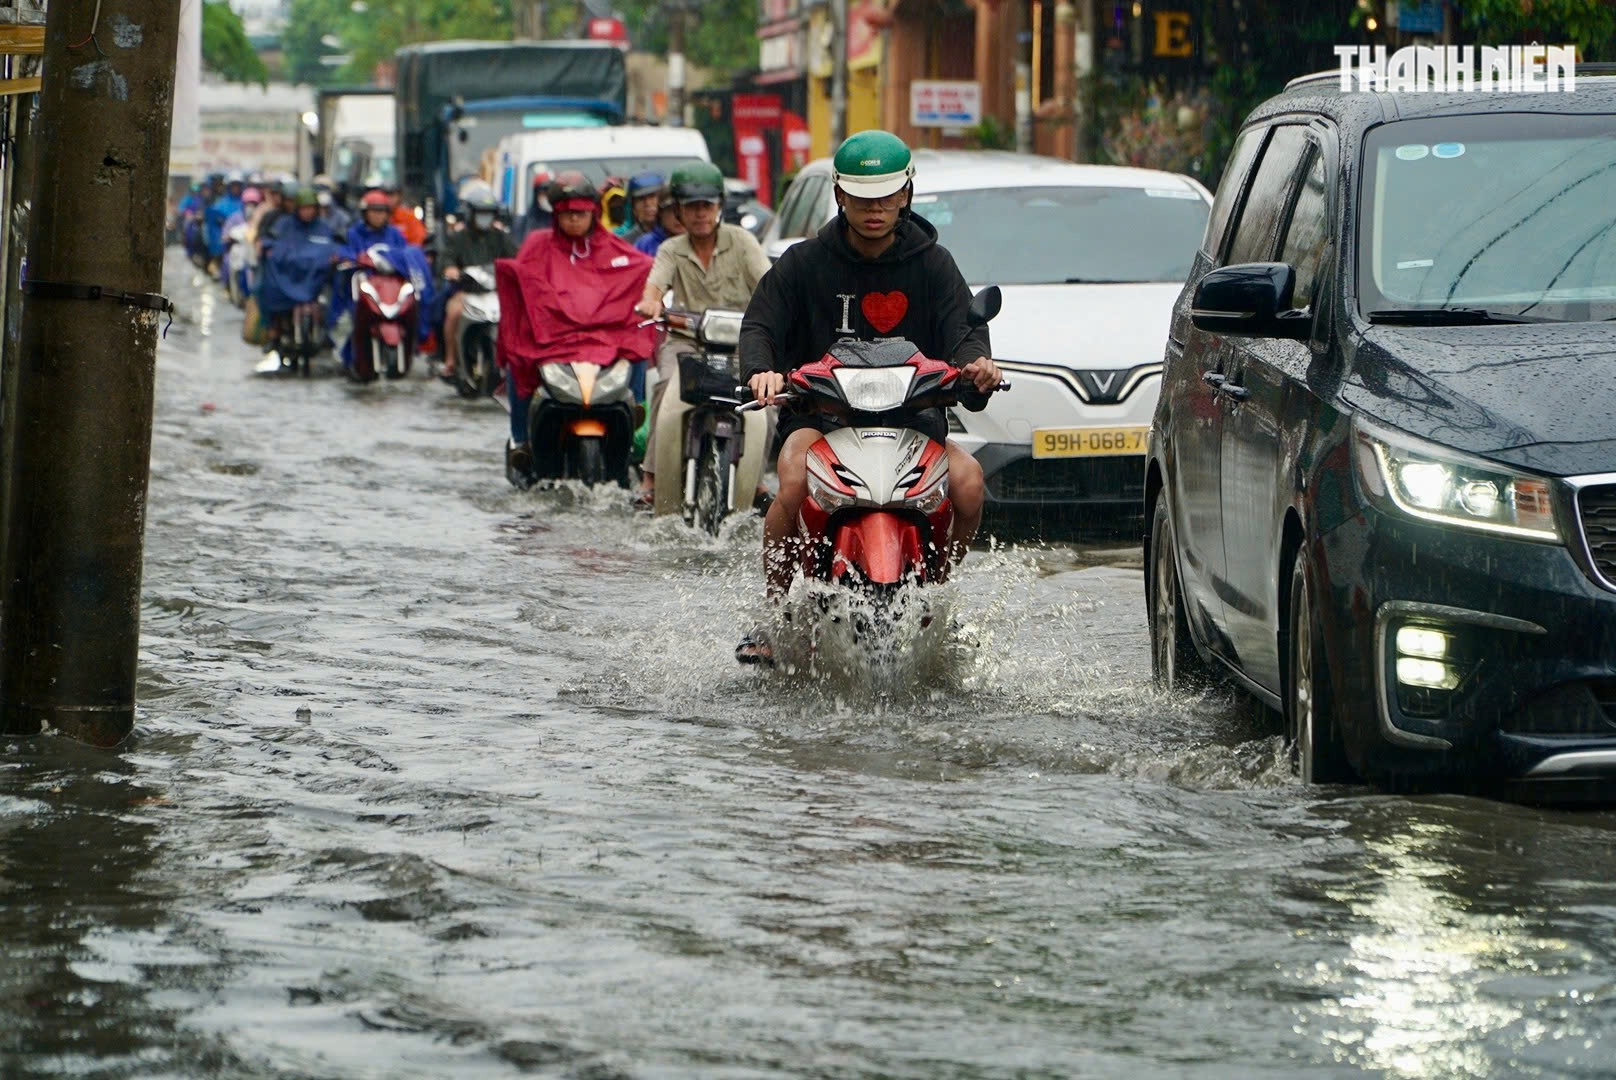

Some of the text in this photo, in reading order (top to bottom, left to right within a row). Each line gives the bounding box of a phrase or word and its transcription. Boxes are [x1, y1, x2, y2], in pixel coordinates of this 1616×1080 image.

[1154, 12, 1192, 56] E
[836, 294, 856, 333] I
[862, 431, 897, 440] HONDA
